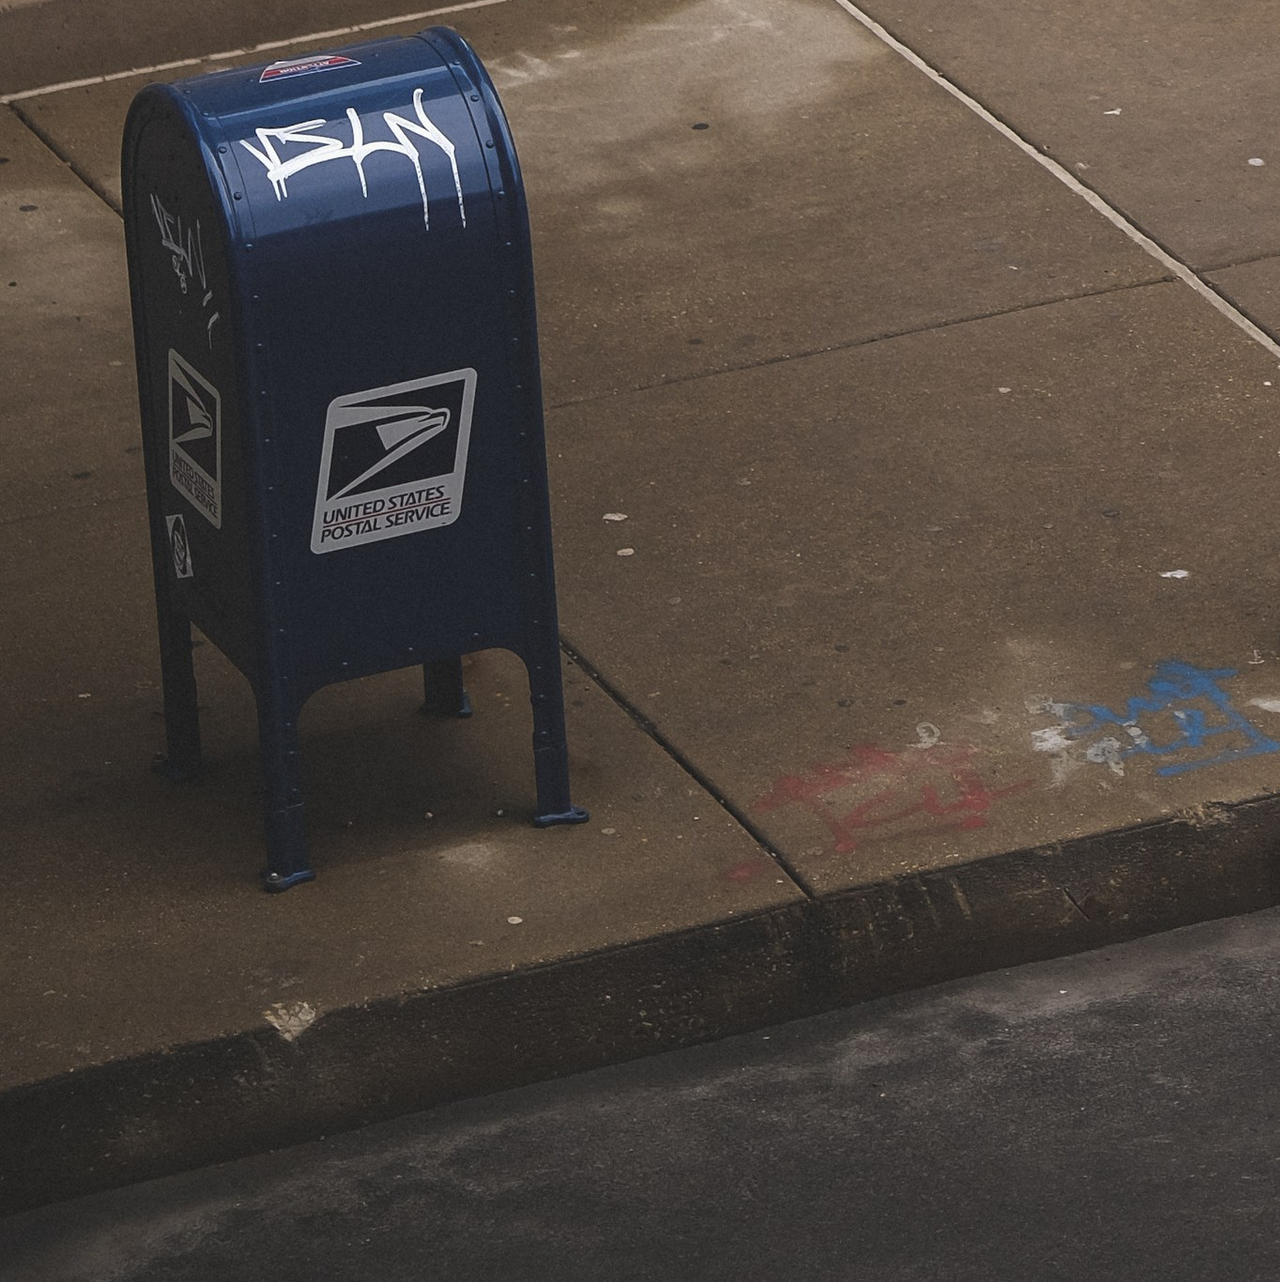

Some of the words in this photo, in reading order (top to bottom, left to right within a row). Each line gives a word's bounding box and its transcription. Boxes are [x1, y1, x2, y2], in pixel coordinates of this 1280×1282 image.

[172, 449, 194, 479] UNITED
[194, 472, 215, 500] STATES
[172, 465, 194, 496] POSTAL
[194, 487, 218, 518] SERVICE
[320, 518, 382, 543] POSTAL
[385, 501, 452, 529] SERVICE
[323, 499, 385, 524] UNITED
[388, 485, 445, 510] STATES
